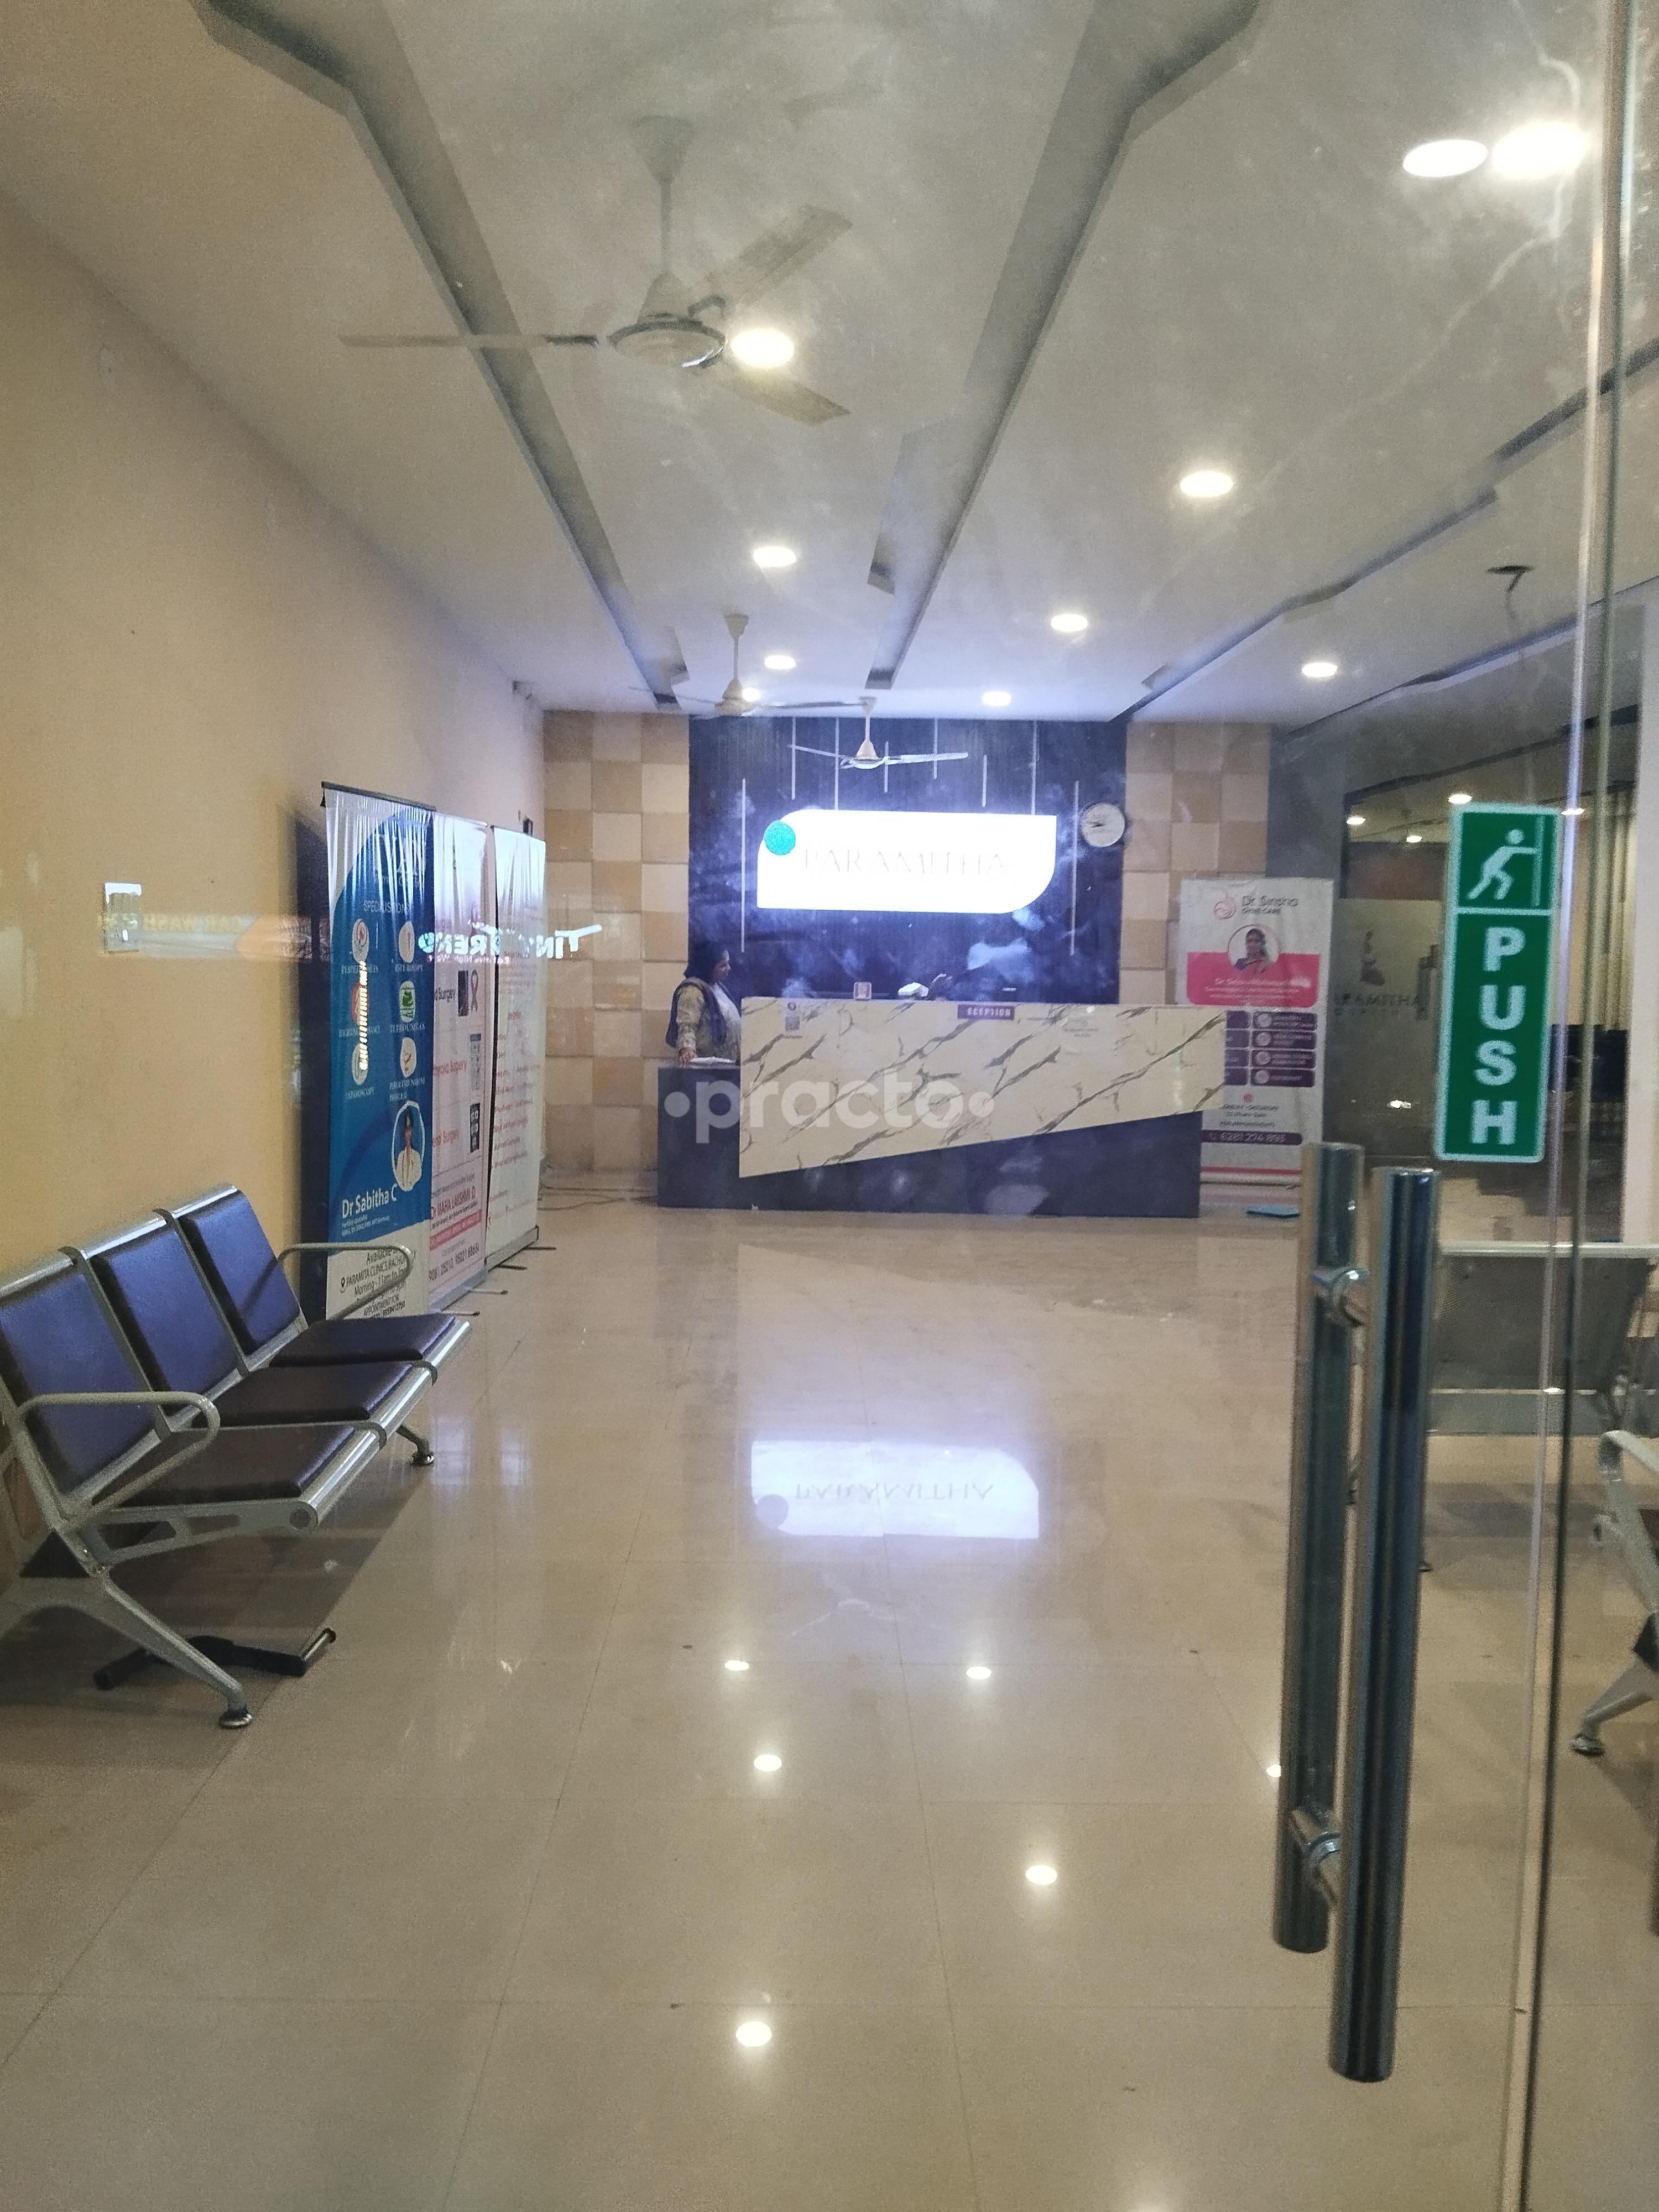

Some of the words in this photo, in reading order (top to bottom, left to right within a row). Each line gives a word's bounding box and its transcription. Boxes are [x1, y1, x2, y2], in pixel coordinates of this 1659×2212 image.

[967, 1005, 1011, 1016] ECEPTION
[1469, 926, 1526, 1145] PUSH
[342, 1199, 353, 1219] Dr
[356, 1188, 389, 1214] Sabitha
